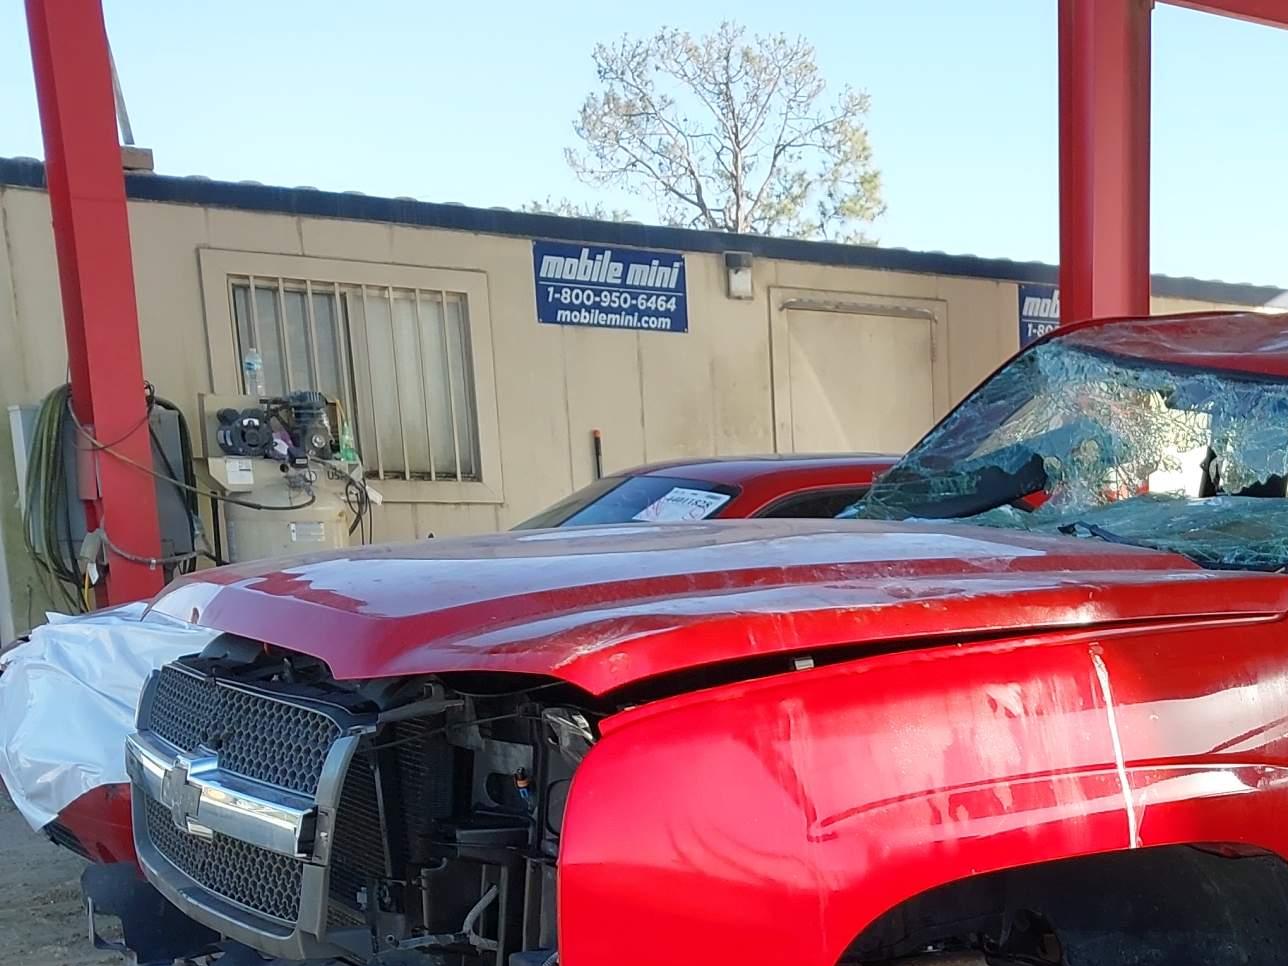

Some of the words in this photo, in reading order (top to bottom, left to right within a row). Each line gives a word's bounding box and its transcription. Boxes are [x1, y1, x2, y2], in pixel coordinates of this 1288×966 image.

[539, 248, 624, 284] mobile
[626, 259, 681, 289] mini
[547, 286, 677, 312] 1-800-950-6464
[1022, 289, 1060, 318] mob
[556, 308, 672, 330] mobilemini.com
